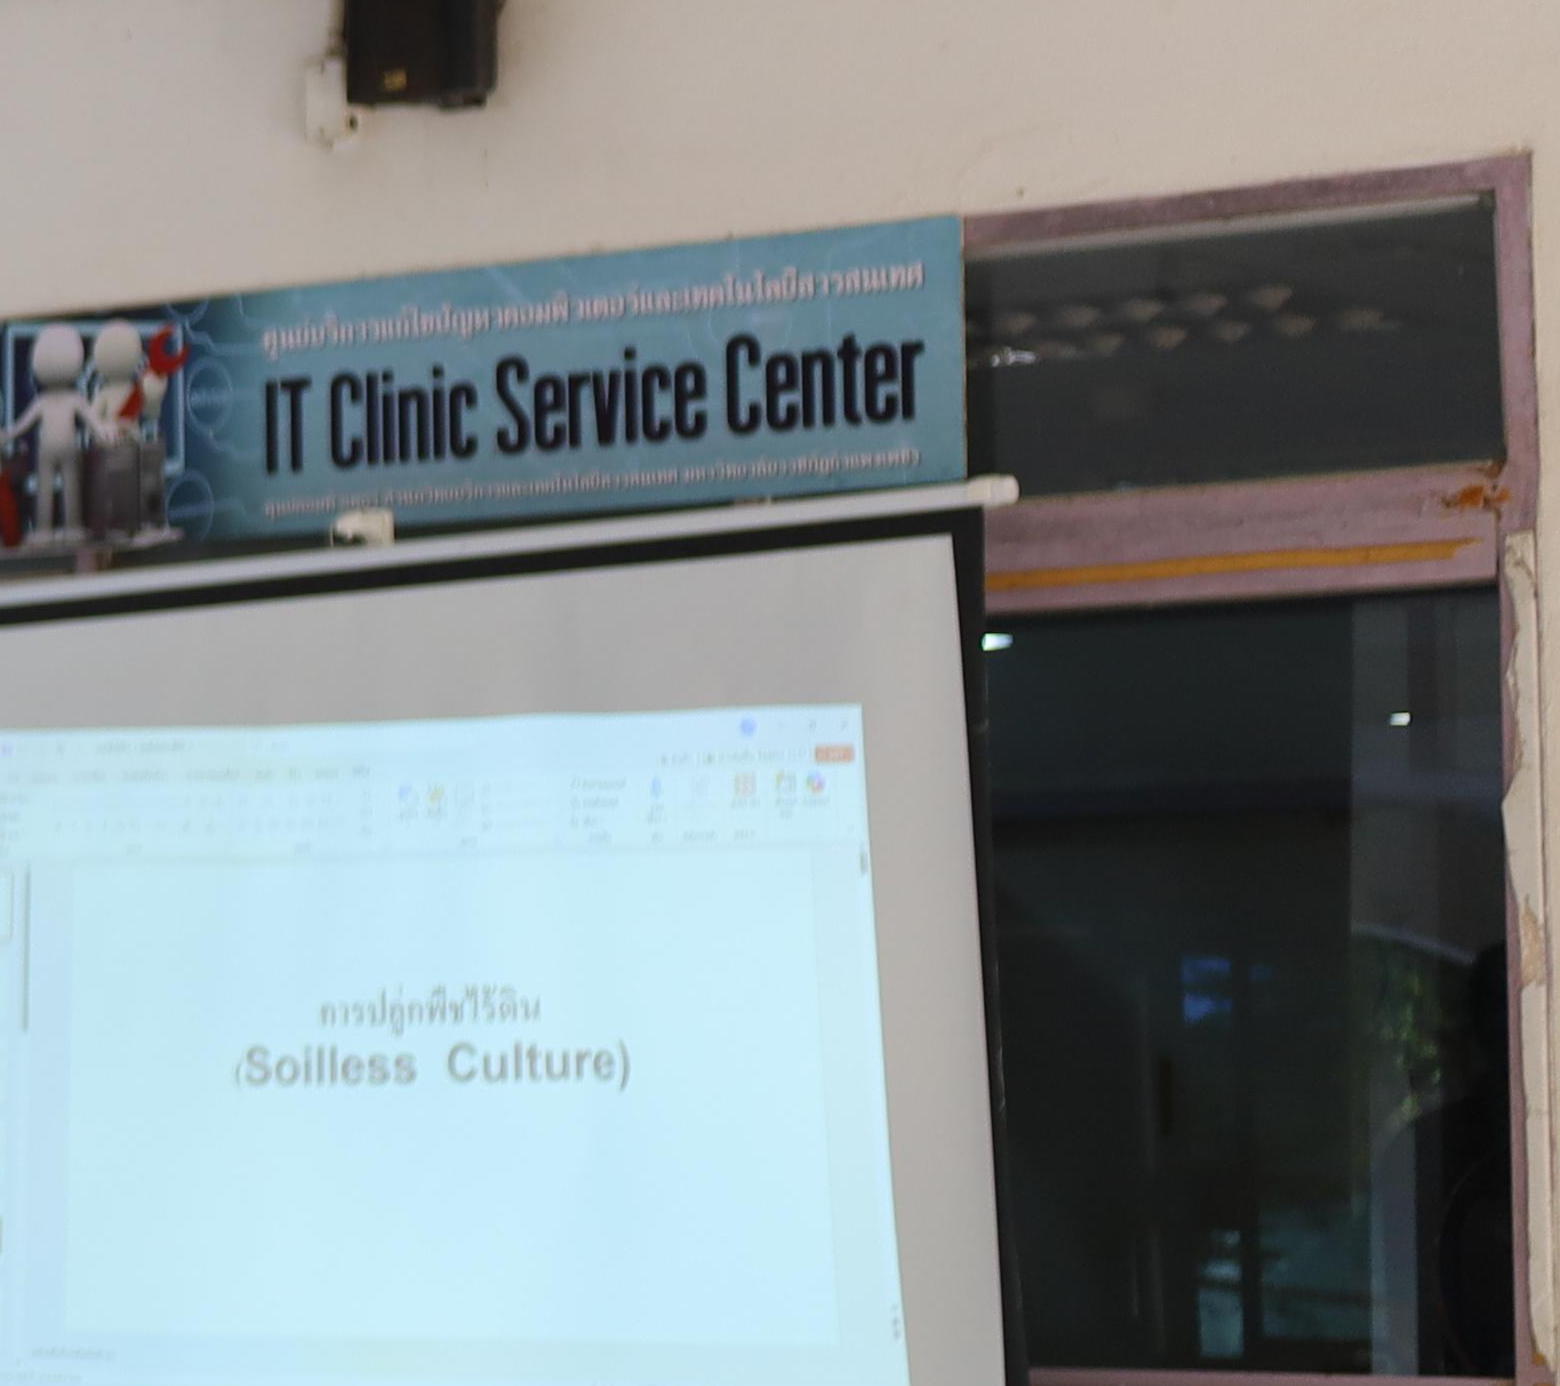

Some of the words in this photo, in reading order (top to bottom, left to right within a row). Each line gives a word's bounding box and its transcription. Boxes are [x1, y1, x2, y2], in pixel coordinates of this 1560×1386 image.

[265, 376, 313, 476] IT
[330, 362, 478, 471] Clinic
[494, 353, 709, 456] Service
[725, 331, 926, 436] Center
[234, 1044, 418, 1088] (Soilless
[446, 1037, 632, 1094] Culture)
